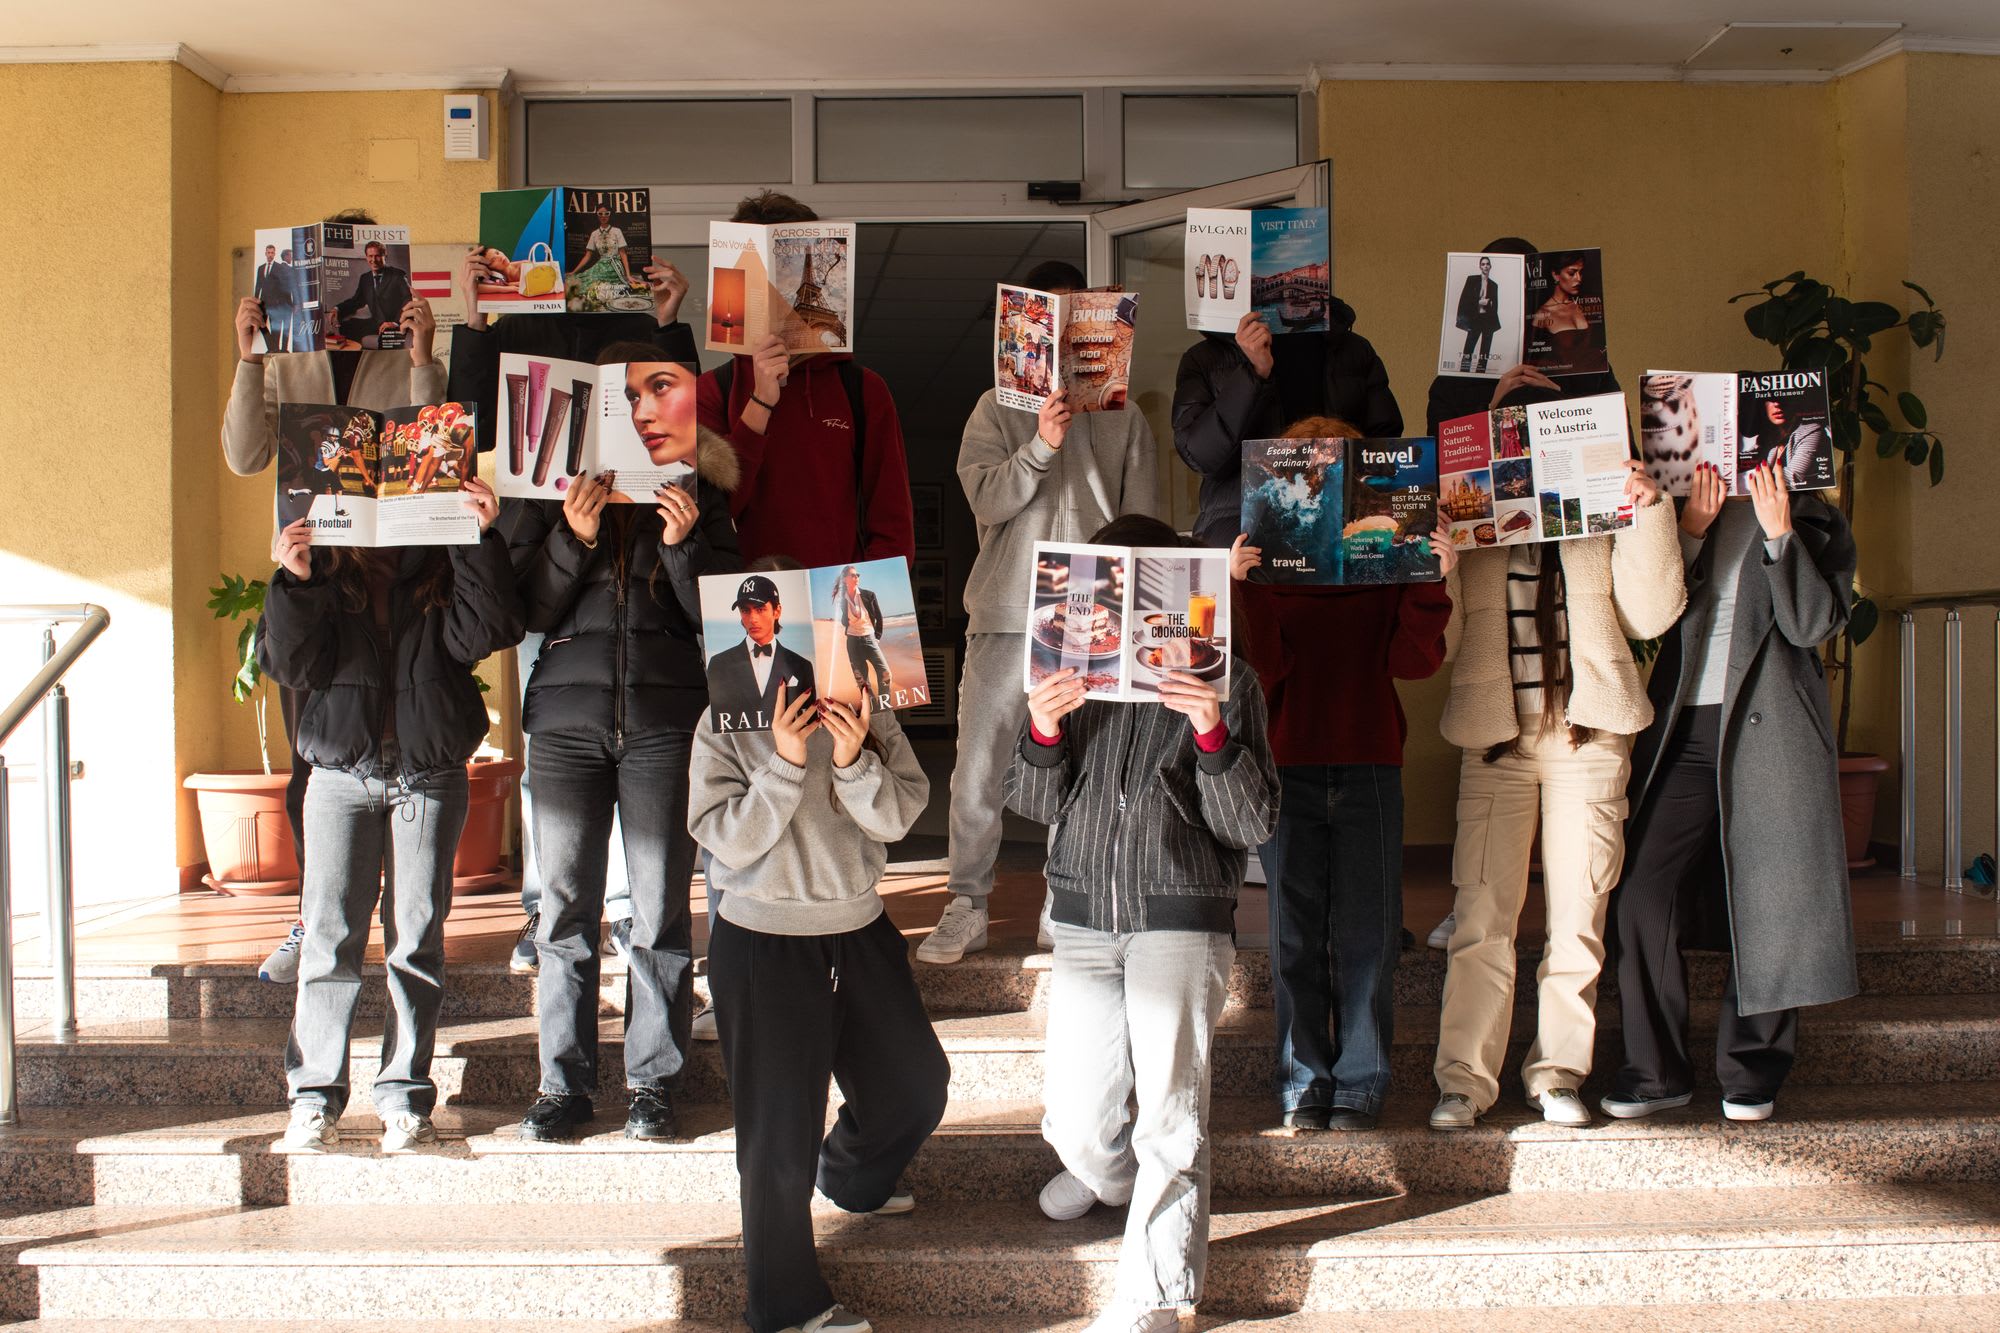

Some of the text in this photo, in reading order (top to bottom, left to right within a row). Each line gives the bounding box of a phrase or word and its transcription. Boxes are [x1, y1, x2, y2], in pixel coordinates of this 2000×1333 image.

[567, 191, 647, 214] ALURE
[1189, 224, 1247, 236] BVLGARI
[1260, 219, 1317, 231] VISIT ITALY
[324, 227, 406, 242] THE JURIST
[772, 228, 850, 239] ACROSS THE
[712, 239, 757, 251] BON VOYAGE
[325, 258, 349, 268] LAWYER
[1073, 309, 1118, 322] EXPLORE
[1073, 365, 1105, 373] WORLD
[1740, 371, 1822, 393] FASHION
[1755, 391, 1772, 399] Dark
[1537, 406, 1593, 421] Welcome
[1443, 423, 1475, 436] Culture.
[1539, 420, 1597, 436] to Austria
[1443, 435, 1473, 447] Nature.
[1266, 445, 1318, 457] Escape the
[1361, 446, 1413, 464] travel
[1443, 444, 1483, 458] Tradition.
[1539, 450, 1546, 458] A
[1272, 458, 1312, 469] ordinary
[1408, 485, 1419, 493] 10
[1407, 494, 1431, 502] PLACES
[1392, 511, 1408, 519] 2026
[318, 518, 352, 528] Football
[1272, 556, 1306, 567] travel
[1069, 592, 1092, 603] THE
[1068, 605, 1091, 617] END
[1167, 613, 1185, 626] THE
[1151, 626, 1201, 639] COOKBOOK
[718, 710, 770, 732] RAL
